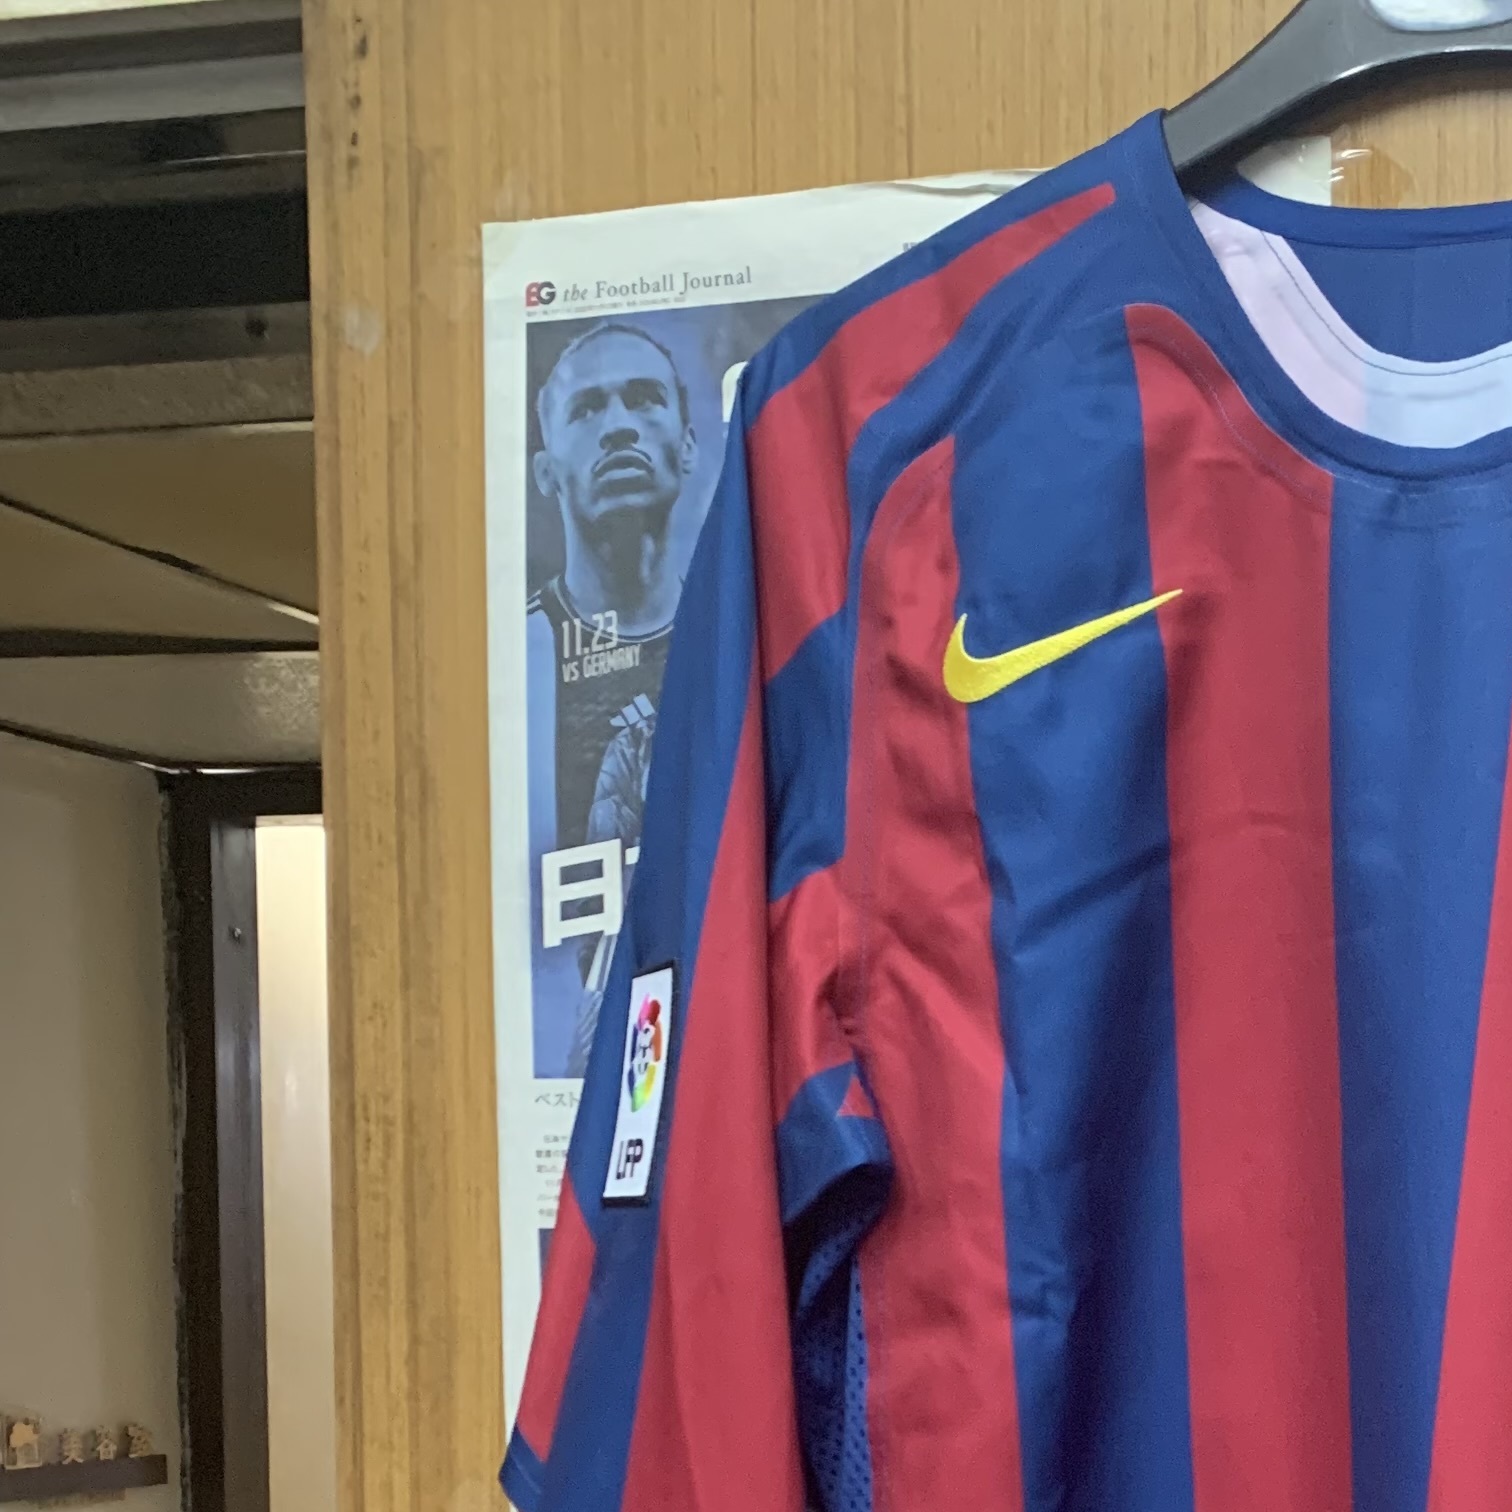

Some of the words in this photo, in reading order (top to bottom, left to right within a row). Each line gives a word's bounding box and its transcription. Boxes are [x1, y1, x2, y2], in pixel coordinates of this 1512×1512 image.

[563, 283, 588, 303] the
[595, 273, 675, 300] Football
[679, 265, 753, 295] Journal
[561, 609, 618, 659] 11.23
[562, 661, 580, 683] VS
[582, 644, 641, 679] GERMANY
